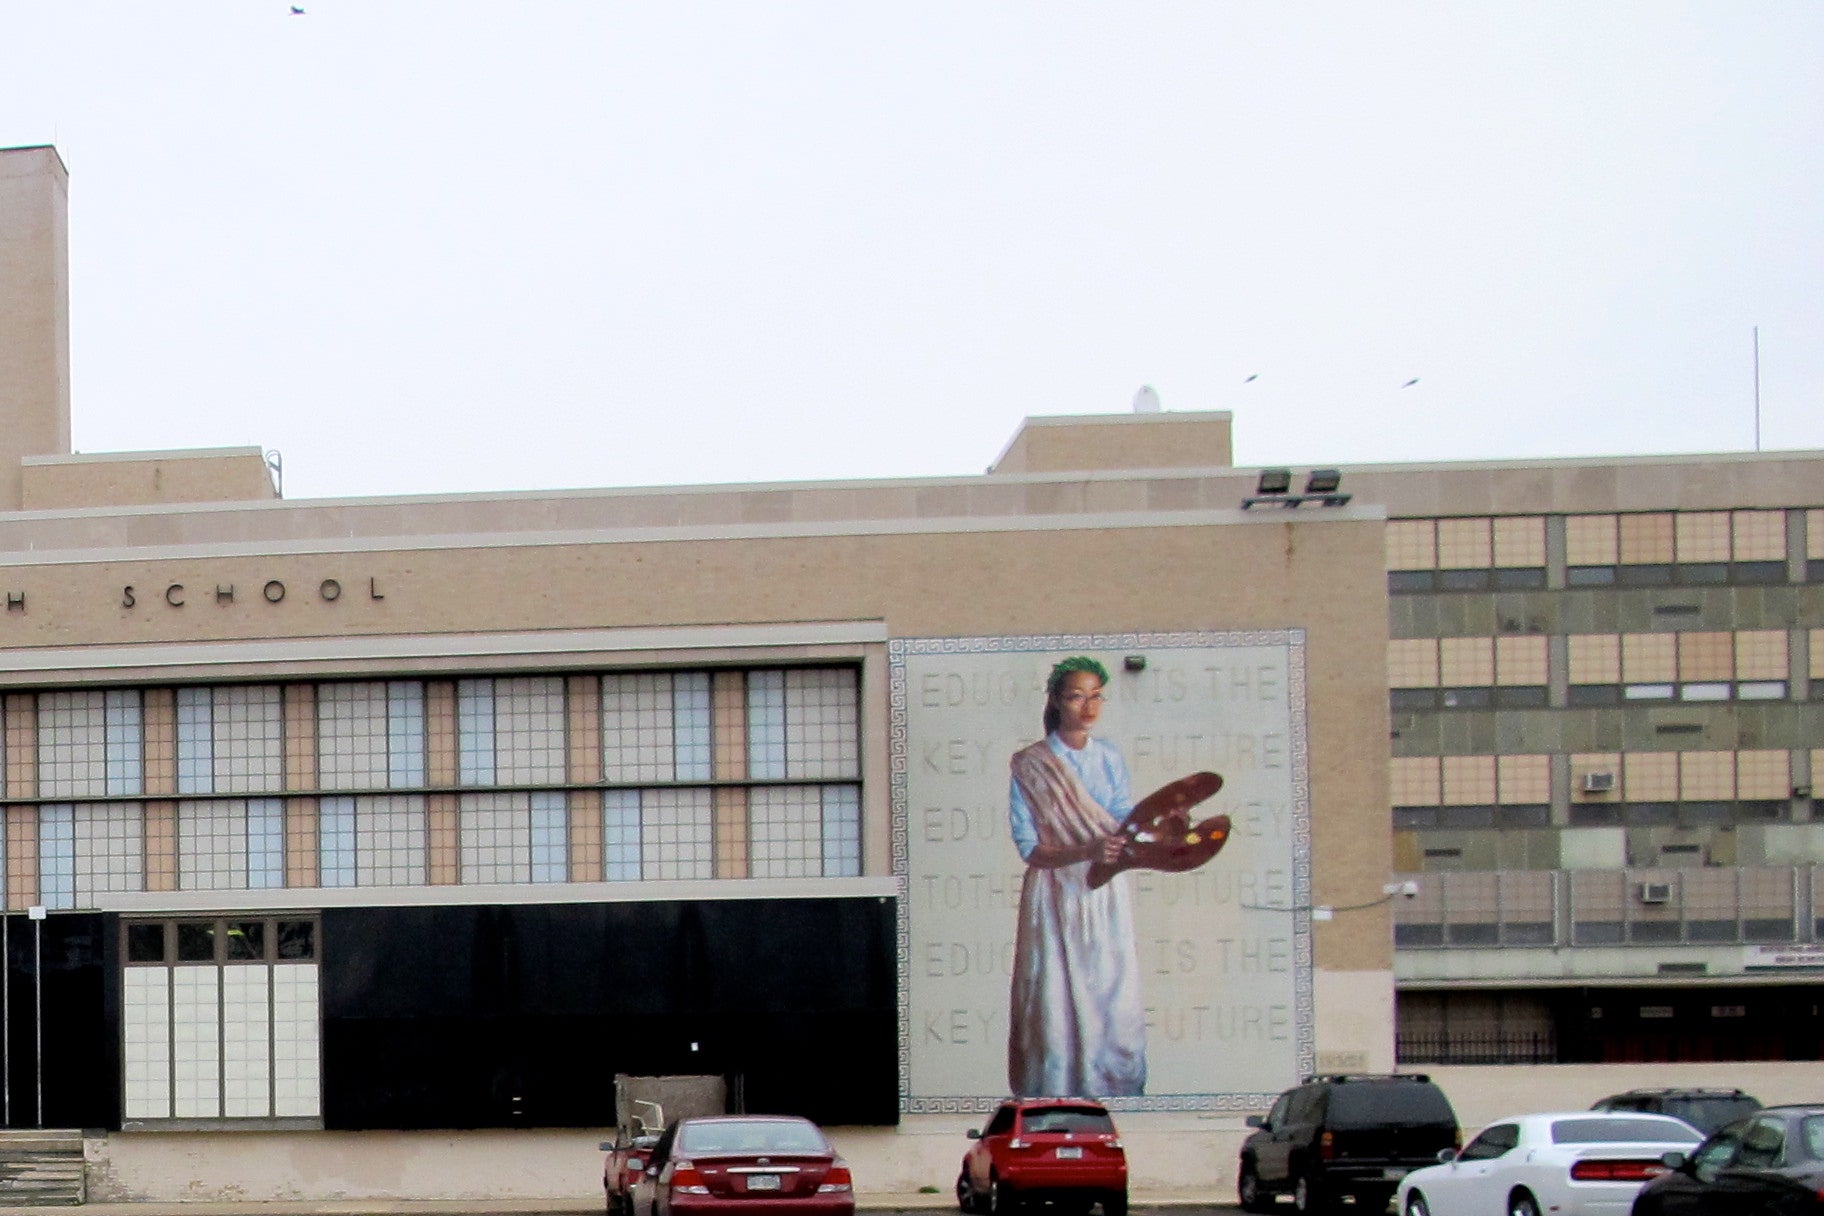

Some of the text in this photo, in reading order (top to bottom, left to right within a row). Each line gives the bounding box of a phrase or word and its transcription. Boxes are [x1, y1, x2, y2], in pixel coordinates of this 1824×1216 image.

[121, 576, 386, 609] SCHOOL
[922, 738, 994, 775] KEY
[1154, 937, 1288, 975] IS THE
[923, 1009, 996, 1046] KEY
